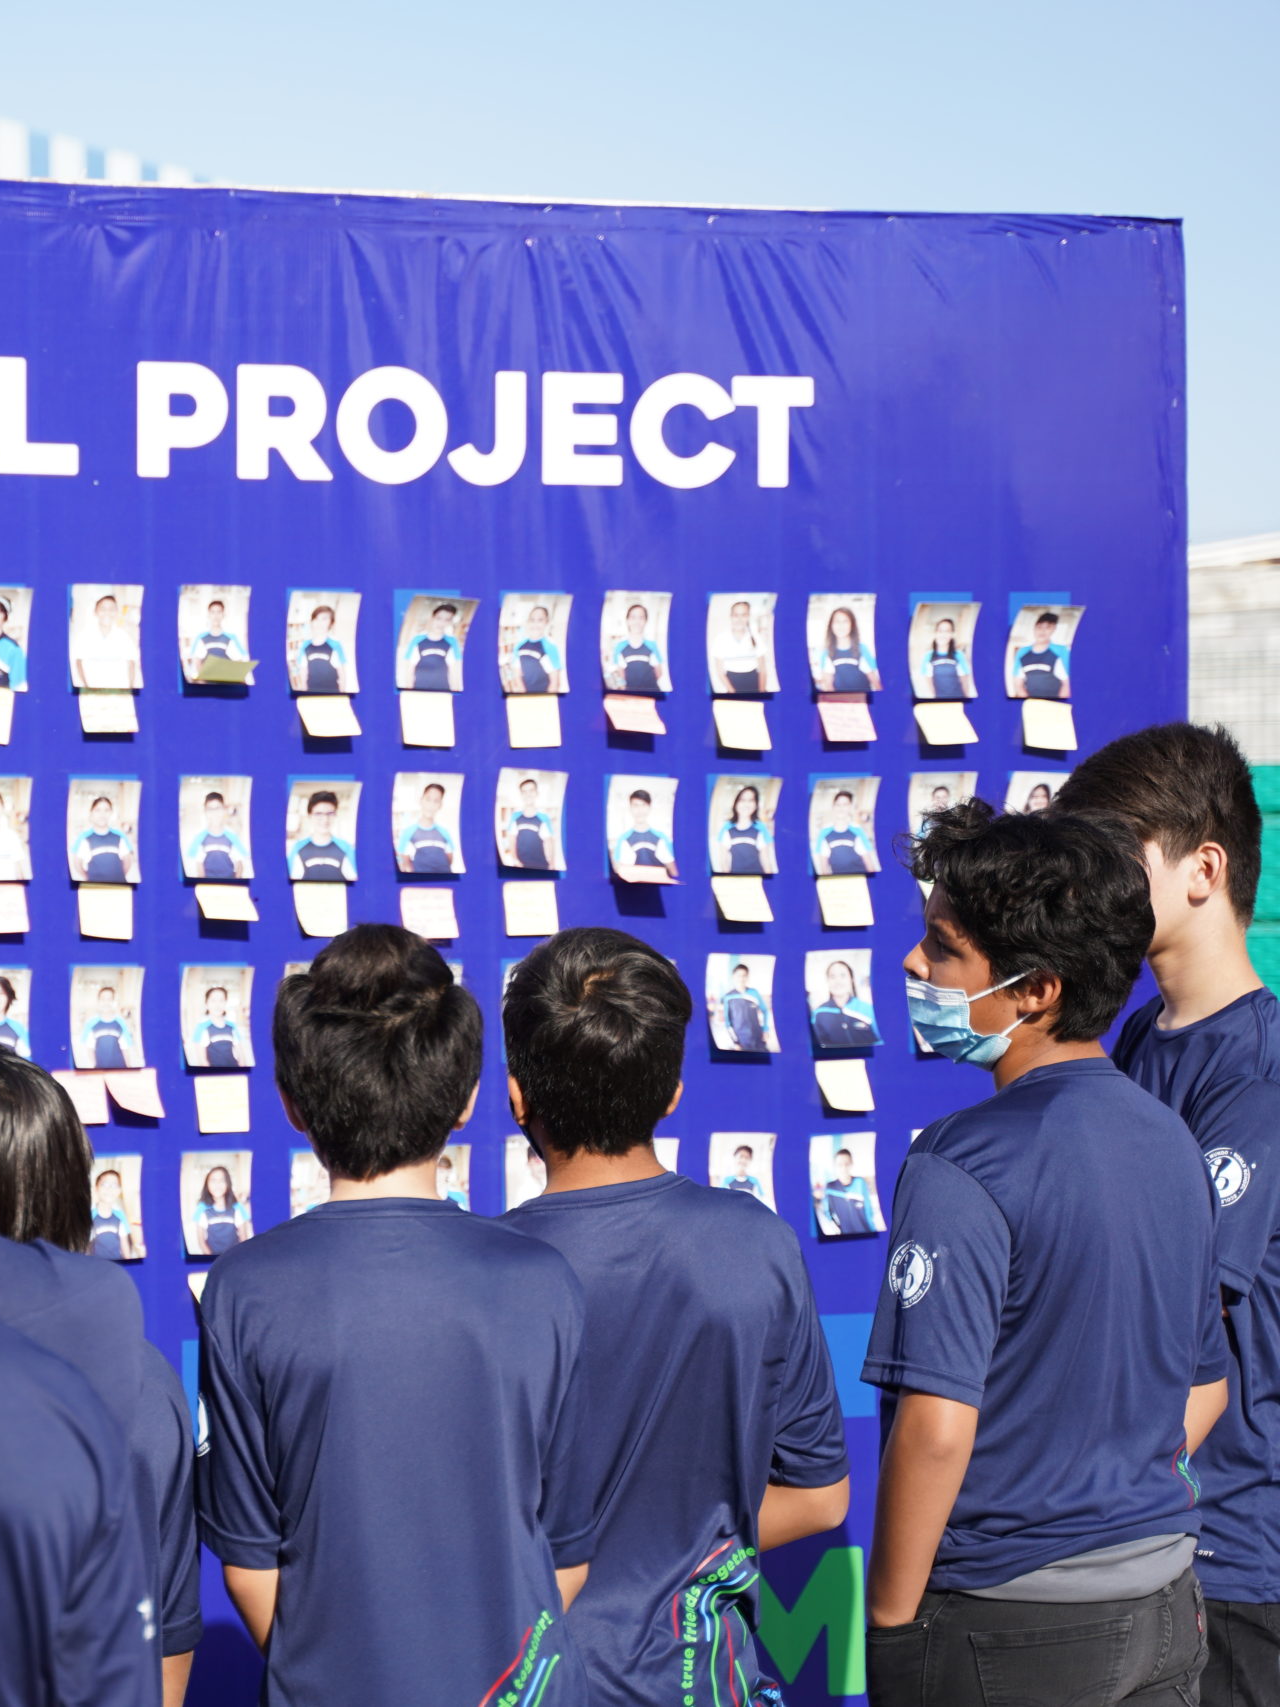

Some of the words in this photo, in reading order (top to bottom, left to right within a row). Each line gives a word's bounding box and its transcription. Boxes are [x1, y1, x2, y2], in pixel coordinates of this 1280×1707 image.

[136, 361, 815, 489] PROJECT
[681, 1647, 696, 1690] true
[698, 1547, 756, 1585] togethe
[757, 1545, 866, 1696] M
